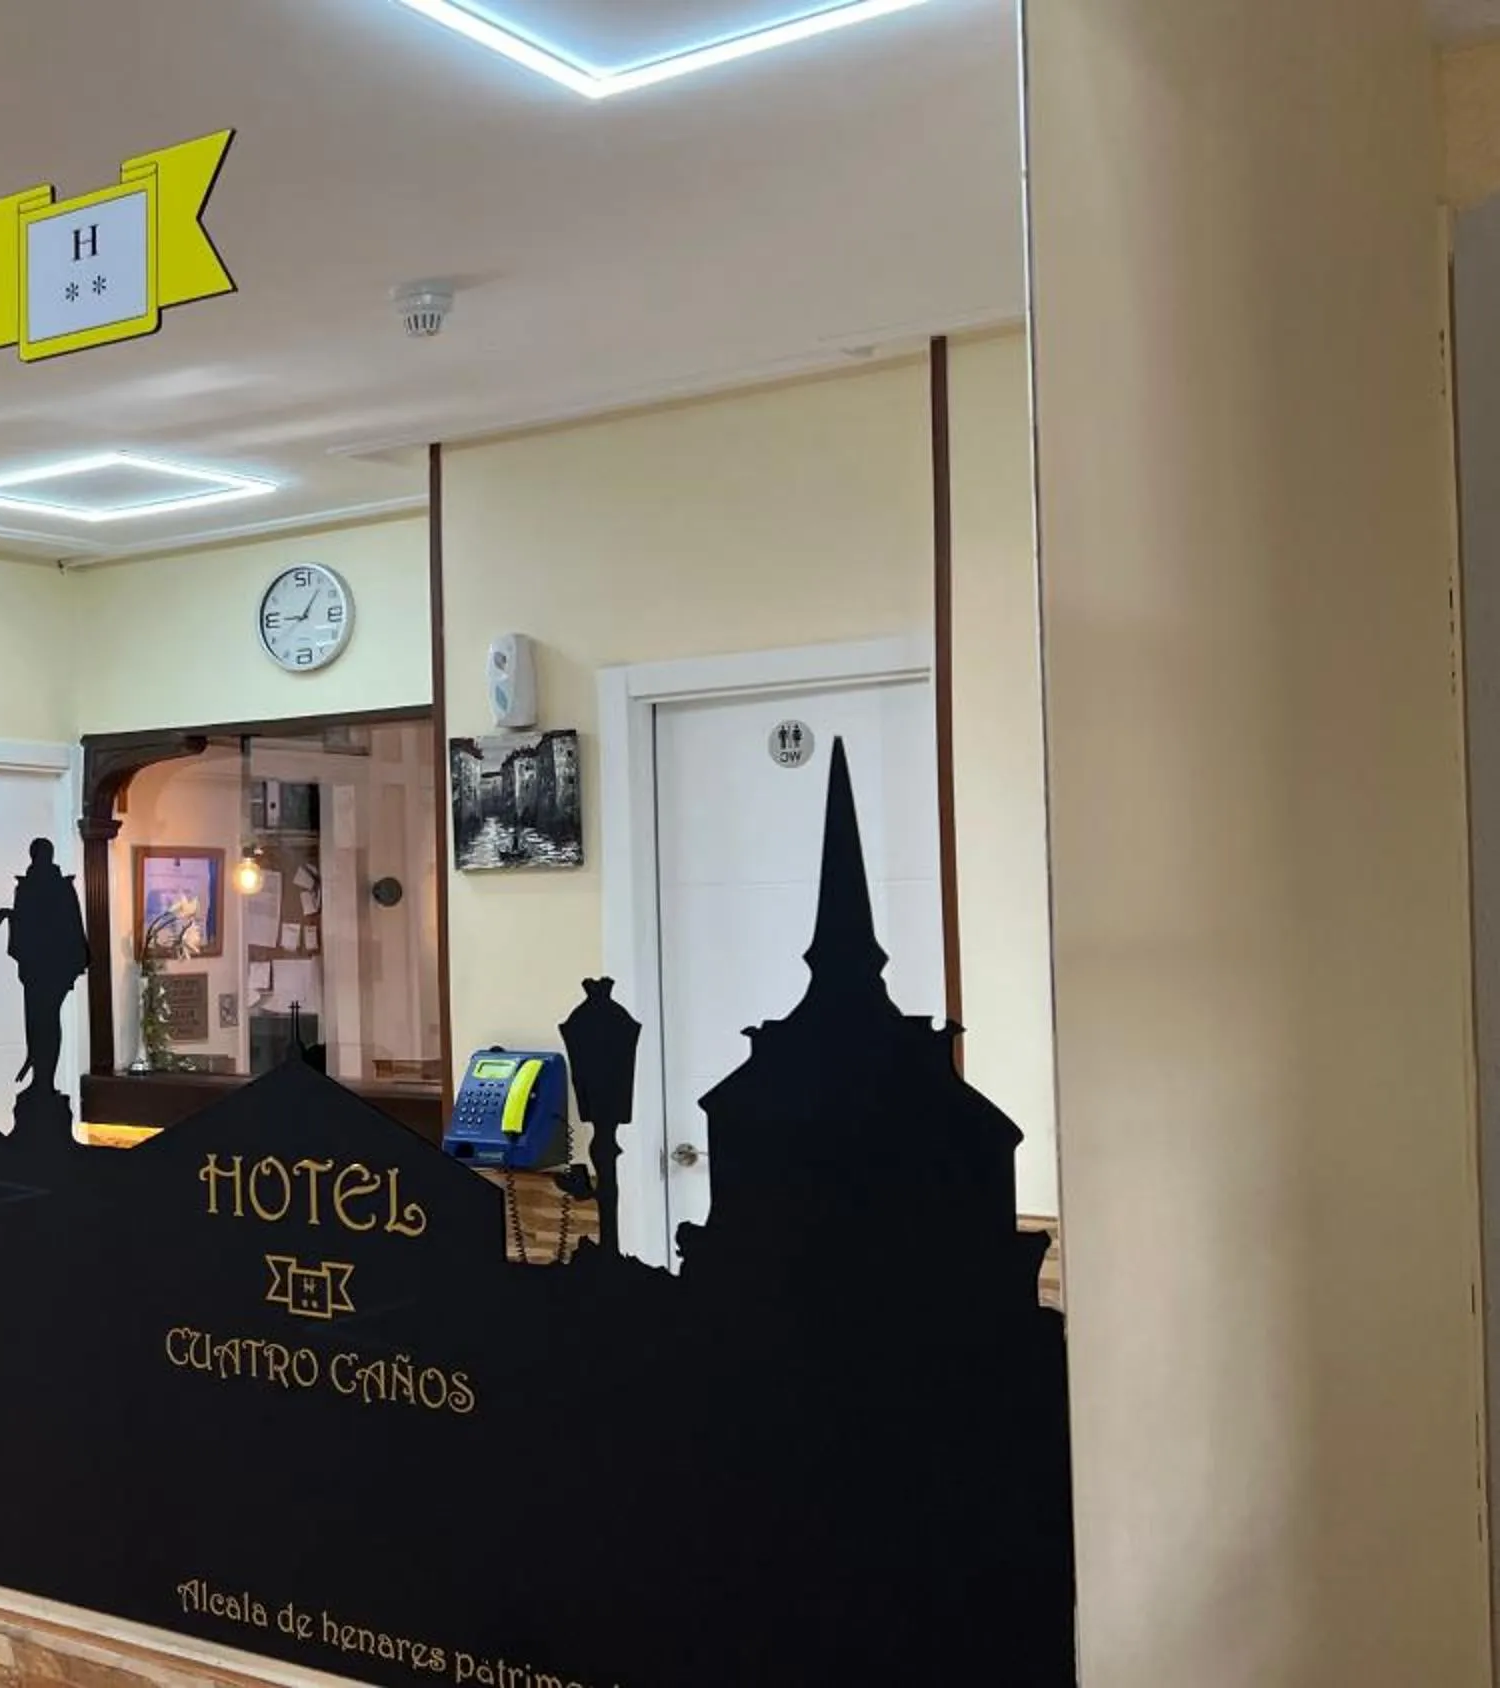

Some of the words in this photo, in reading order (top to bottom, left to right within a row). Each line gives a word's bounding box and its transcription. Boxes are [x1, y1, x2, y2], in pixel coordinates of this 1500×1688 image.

[72, 223, 100, 262] H
[199, 1153, 427, 1237] HOTEL
[165, 1327, 320, 1389] CUATRO
[330, 1352, 476, 1414] CAÑOS
[177, 1578, 268, 1628] Alcala
[277, 1603, 313, 1640] de
[322, 1610, 446, 1673] henares
